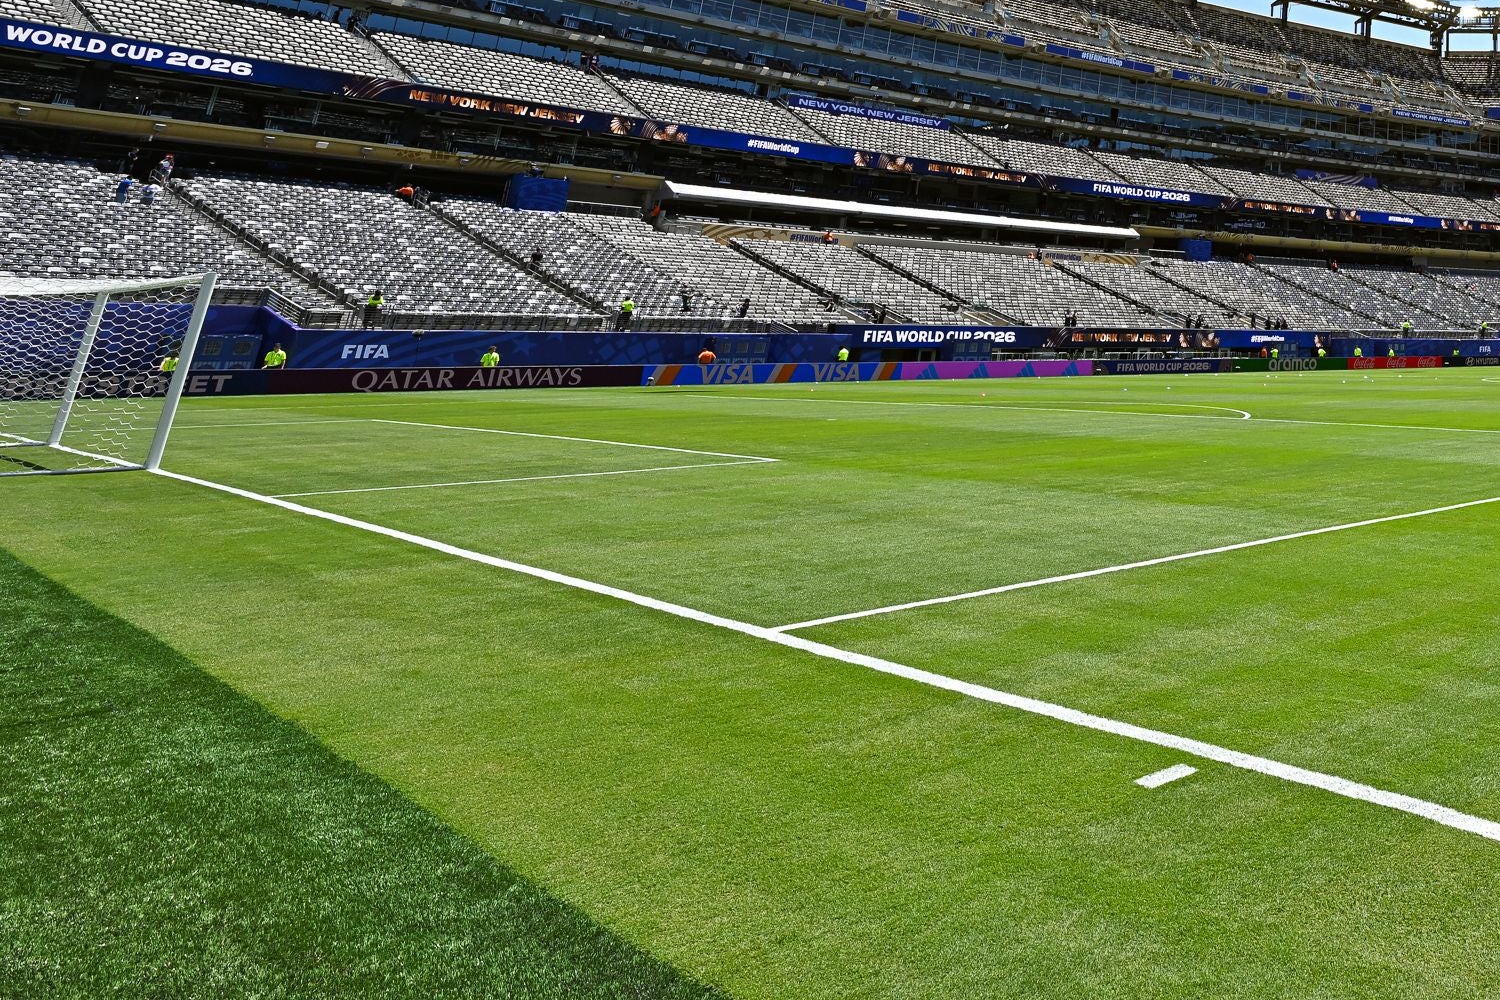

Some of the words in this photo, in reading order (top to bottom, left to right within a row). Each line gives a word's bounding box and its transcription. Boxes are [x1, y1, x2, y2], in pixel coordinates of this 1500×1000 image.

[6, 25, 106, 53] WORLD
[111, 43, 164, 62] CUP
[166, 52, 252, 76] 2026
[1081, 52, 1122, 67] #FIFAWorldCup
[409, 90, 447, 103] NEW
[450, 97, 490, 111] YORK
[494, 103, 529, 115] NEW
[529, 108, 584, 123] JERSEY
[798, 98, 829, 109] NEW
[831, 103, 865, 115] YORK
[867, 109, 895, 119] NEW
[896, 113, 941, 127] JERSEY
[747, 139, 800, 155] #FIFAWorldCup
[927, 163, 949, 173] NEW
[950, 165, 973, 177] YORK
[994, 171, 1027, 183] JERSEY
[1093, 184, 1111, 194] FIFA
[1112, 186, 1143, 198] WORLD
[1144, 189, 1161, 199] CUP
[1161, 191, 1190, 202] 2026
[790, 234, 839, 245] #FIFAWorlup
[863, 330, 893, 342] FIFA
[895, 331, 945, 342] WORLD
[973, 331, 1015, 342] 2026
[1071, 333, 1094, 342] NEW
[1095, 333, 1118, 342] YORK
[1139, 333, 1171, 342] JERSEY
[341, 345, 389, 359] FIFA
[1116, 363, 1134, 372] FIFA
[1134, 363, 1165, 372] WORLD
[1166, 362, 1182, 371] CUP
[1182, 362, 1208, 371] 2026
[1268, 358, 1317, 371] aramco
[1475, 357, 1499, 365] HYUNDAI
[351, 370, 454, 392] QATAR
[467, 367, 582, 387] AIRWAYS
[700, 364, 753, 384] VISA
[811, 363, 860, 382] VISA
